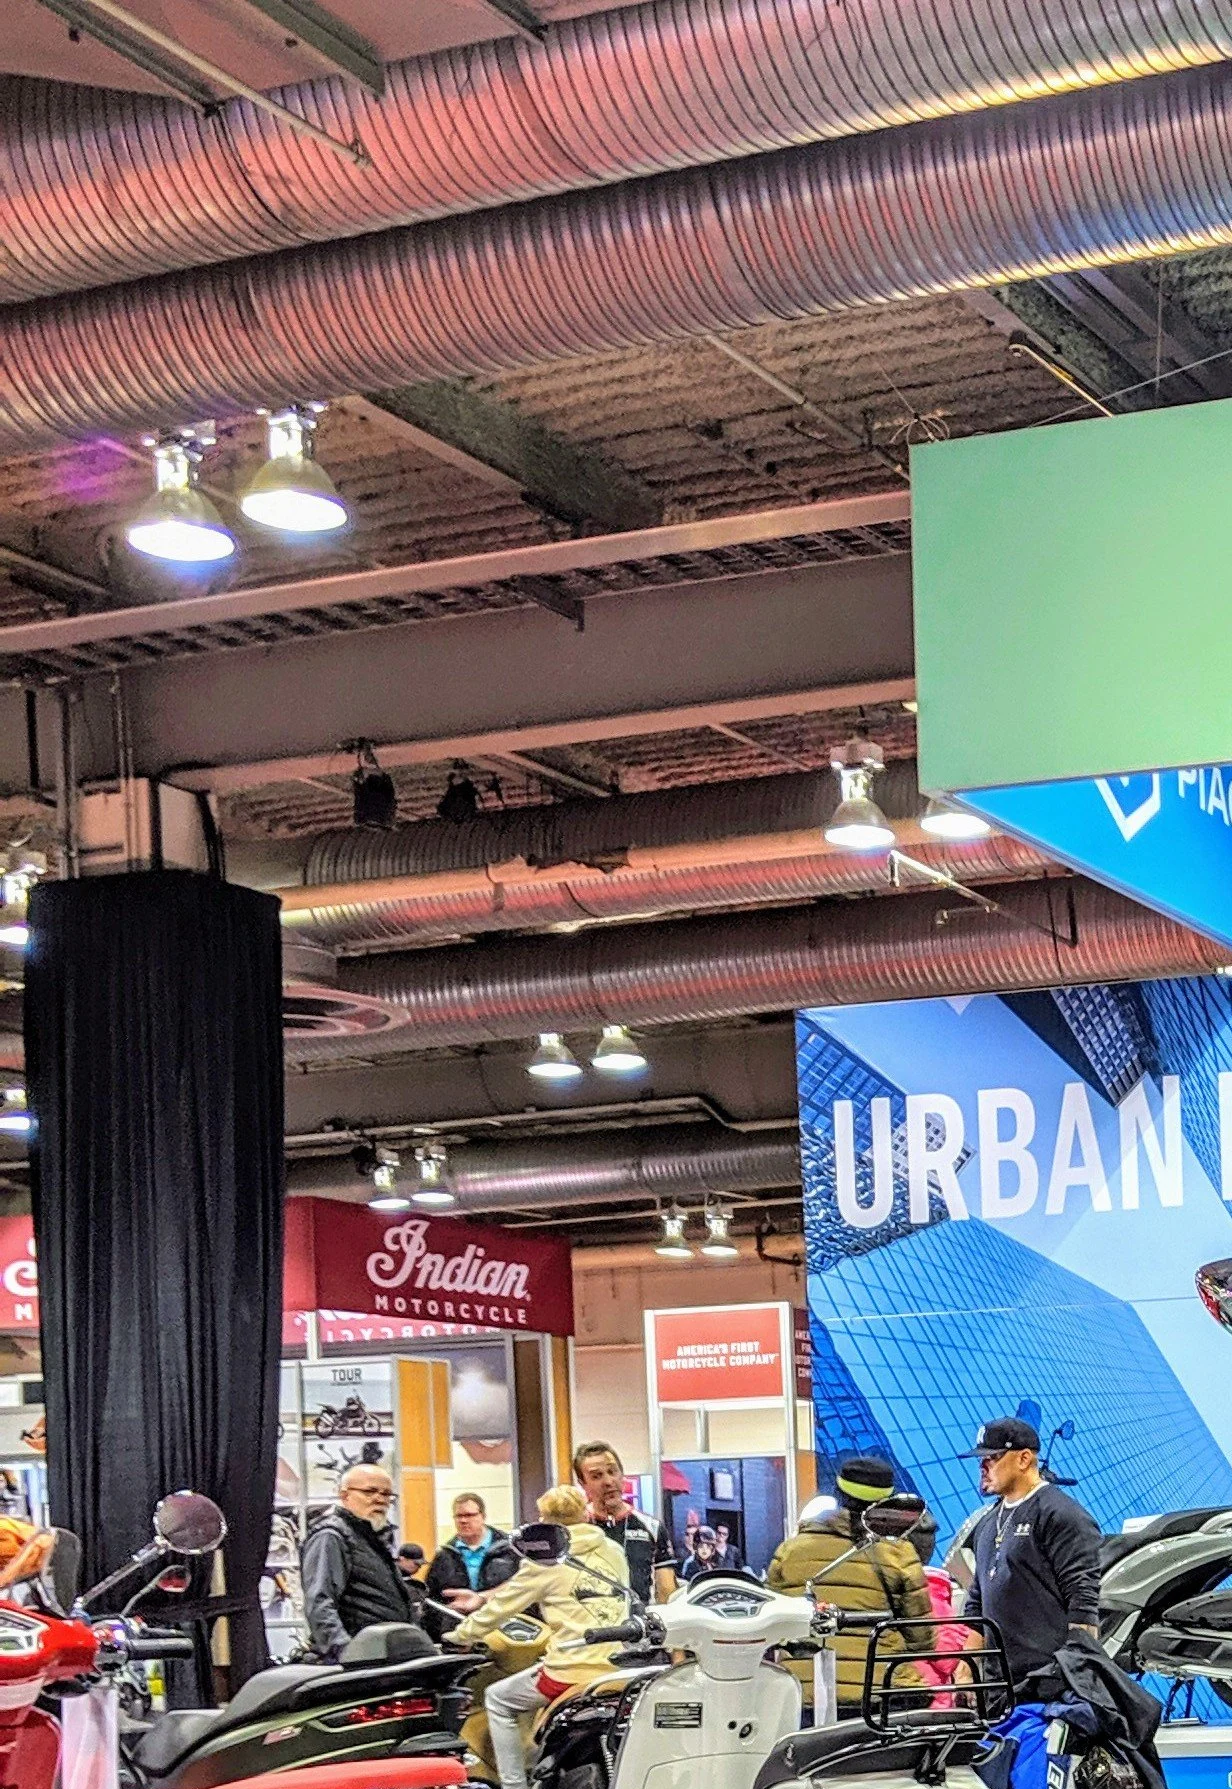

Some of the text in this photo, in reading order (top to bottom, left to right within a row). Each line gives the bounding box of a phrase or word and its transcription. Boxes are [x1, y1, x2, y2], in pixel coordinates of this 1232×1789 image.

[833, 1073, 1184, 1230] URBAN
[366, 1218, 530, 1300] Indian
[374, 1293, 528, 1325] MOTORCYCLE
[676, 1341, 760, 1357] AMERICA'S FIRST
[331, 1368, 363, 1382] TOUR
[662, 1356, 727, 1370] MOTORCYCLE
